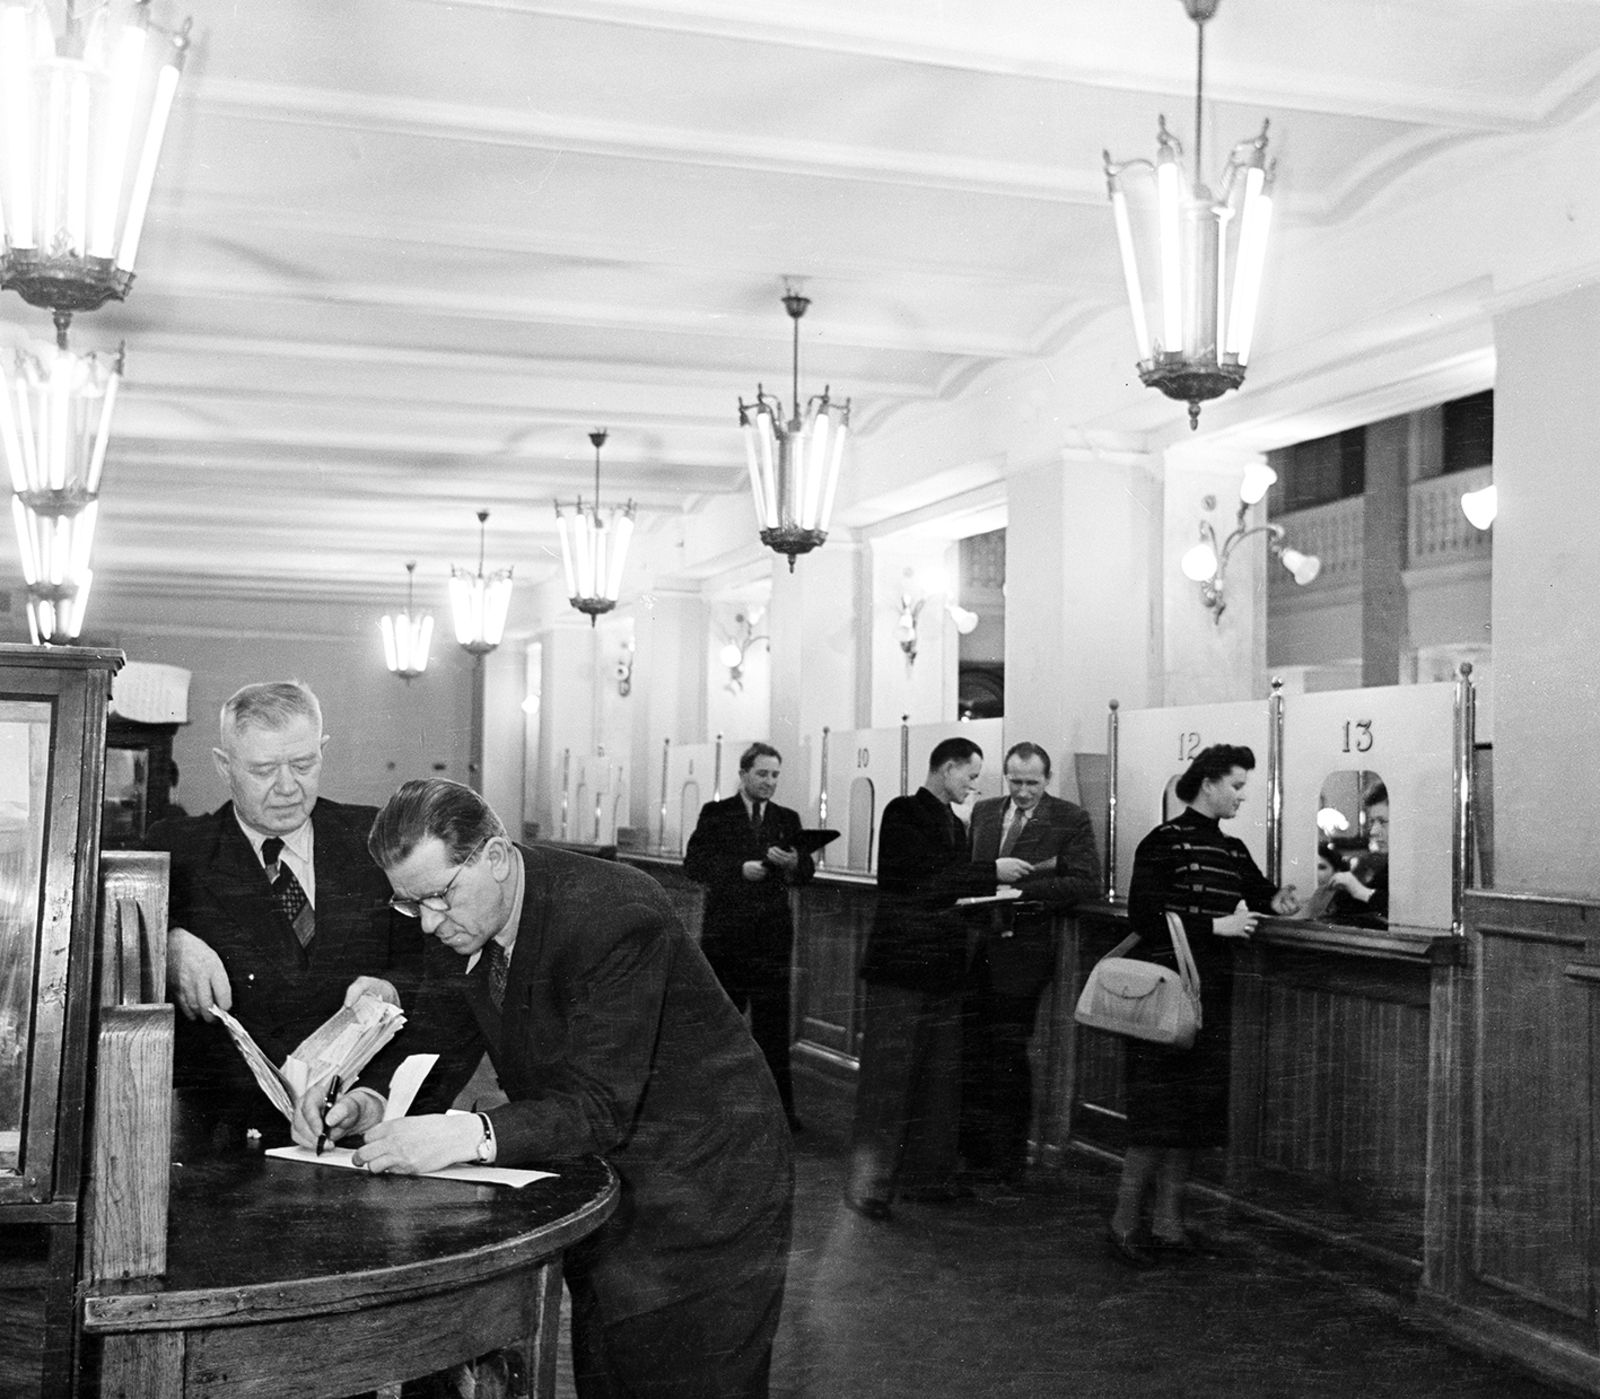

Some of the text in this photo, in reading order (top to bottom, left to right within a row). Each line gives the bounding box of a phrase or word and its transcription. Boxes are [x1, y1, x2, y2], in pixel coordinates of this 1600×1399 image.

[1177, 732, 1201, 761] 12
[1341, 719, 1374, 753] 13
[857, 747, 870, 768] 10
